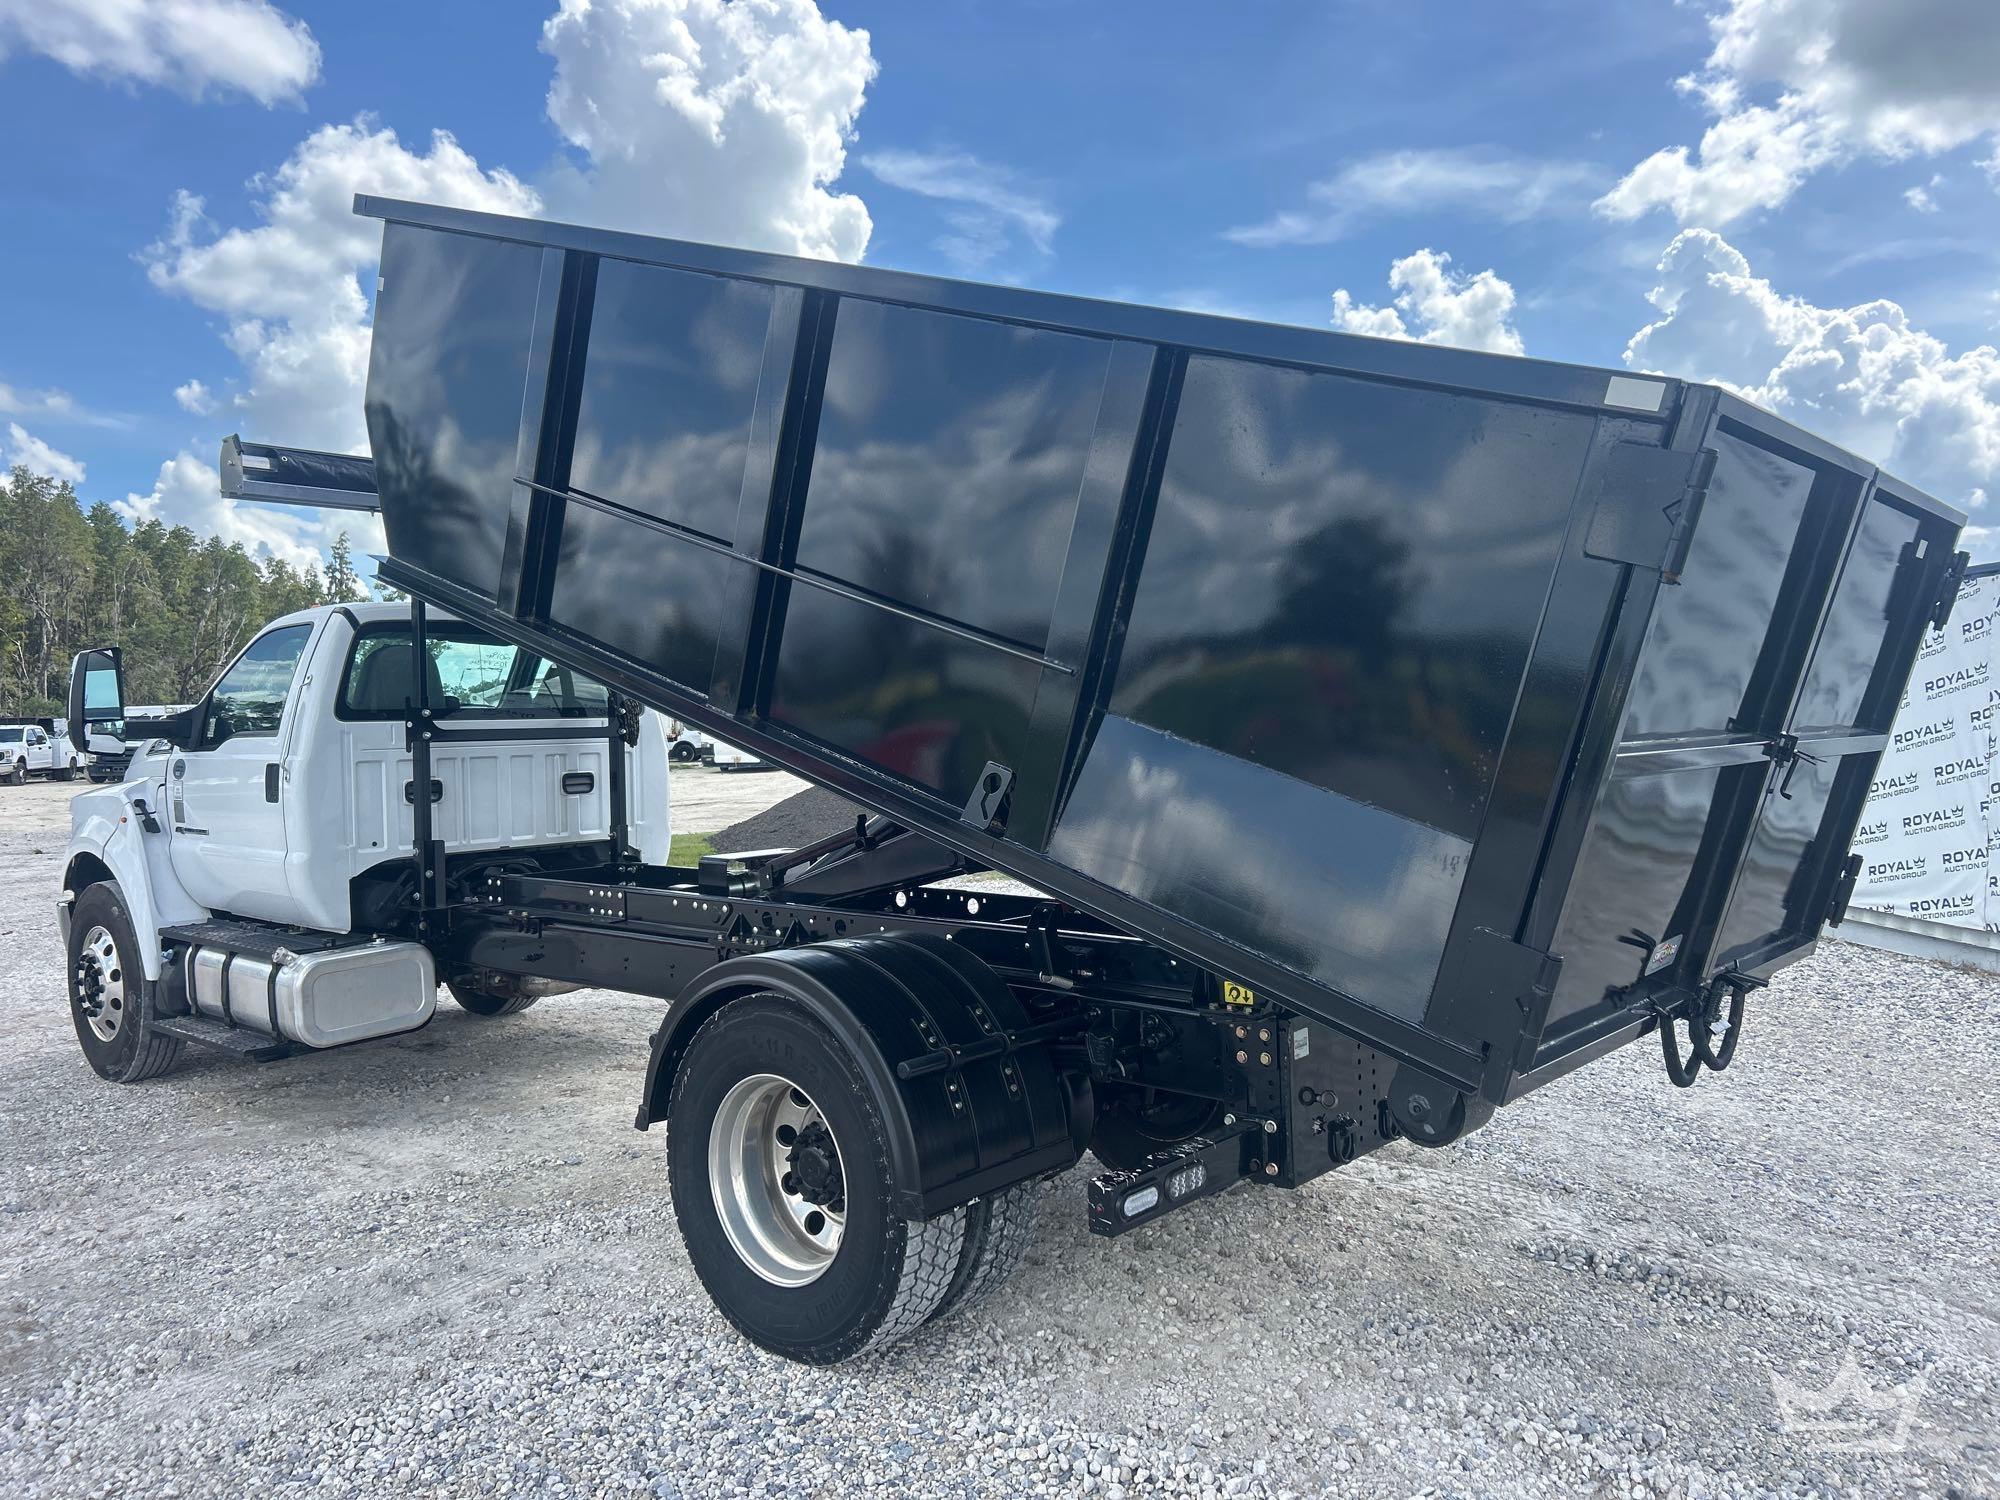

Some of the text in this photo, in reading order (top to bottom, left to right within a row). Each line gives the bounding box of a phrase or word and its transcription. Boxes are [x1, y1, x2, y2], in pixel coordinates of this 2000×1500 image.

[1957, 587, 1981, 601] ROUP
[1962, 613, 1994, 636] ROY
[1920, 645, 1947, 659] GROUP
[1925, 669, 1974, 692] ROYAL
[1927, 675, 1990, 702] AUCTION GROUP
[1894, 723, 1942, 745] ROYAL
[1895, 731, 1957, 754] AUCTION GROUP
[1934, 756, 1984, 778] ROYAL
[1869, 776, 1906, 794] OYAL
[1936, 768, 1989, 787] AUCTION GRO
[1867, 785, 1920, 803] UCTION GROUP
[1903, 810, 1951, 828] ROYAL
[1904, 819, 1966, 837] AUCTION GROUP
[1864, 834, 1889, 845] GROUP
[1868, 859, 1914, 877] ROYAL
[1944, 863, 1980, 874] AUCTION
[1869, 870, 1928, 885] AUCTION GROUP
[1910, 896, 1960, 913] ROYAL
[1946, 908, 1975, 918] GROUP
